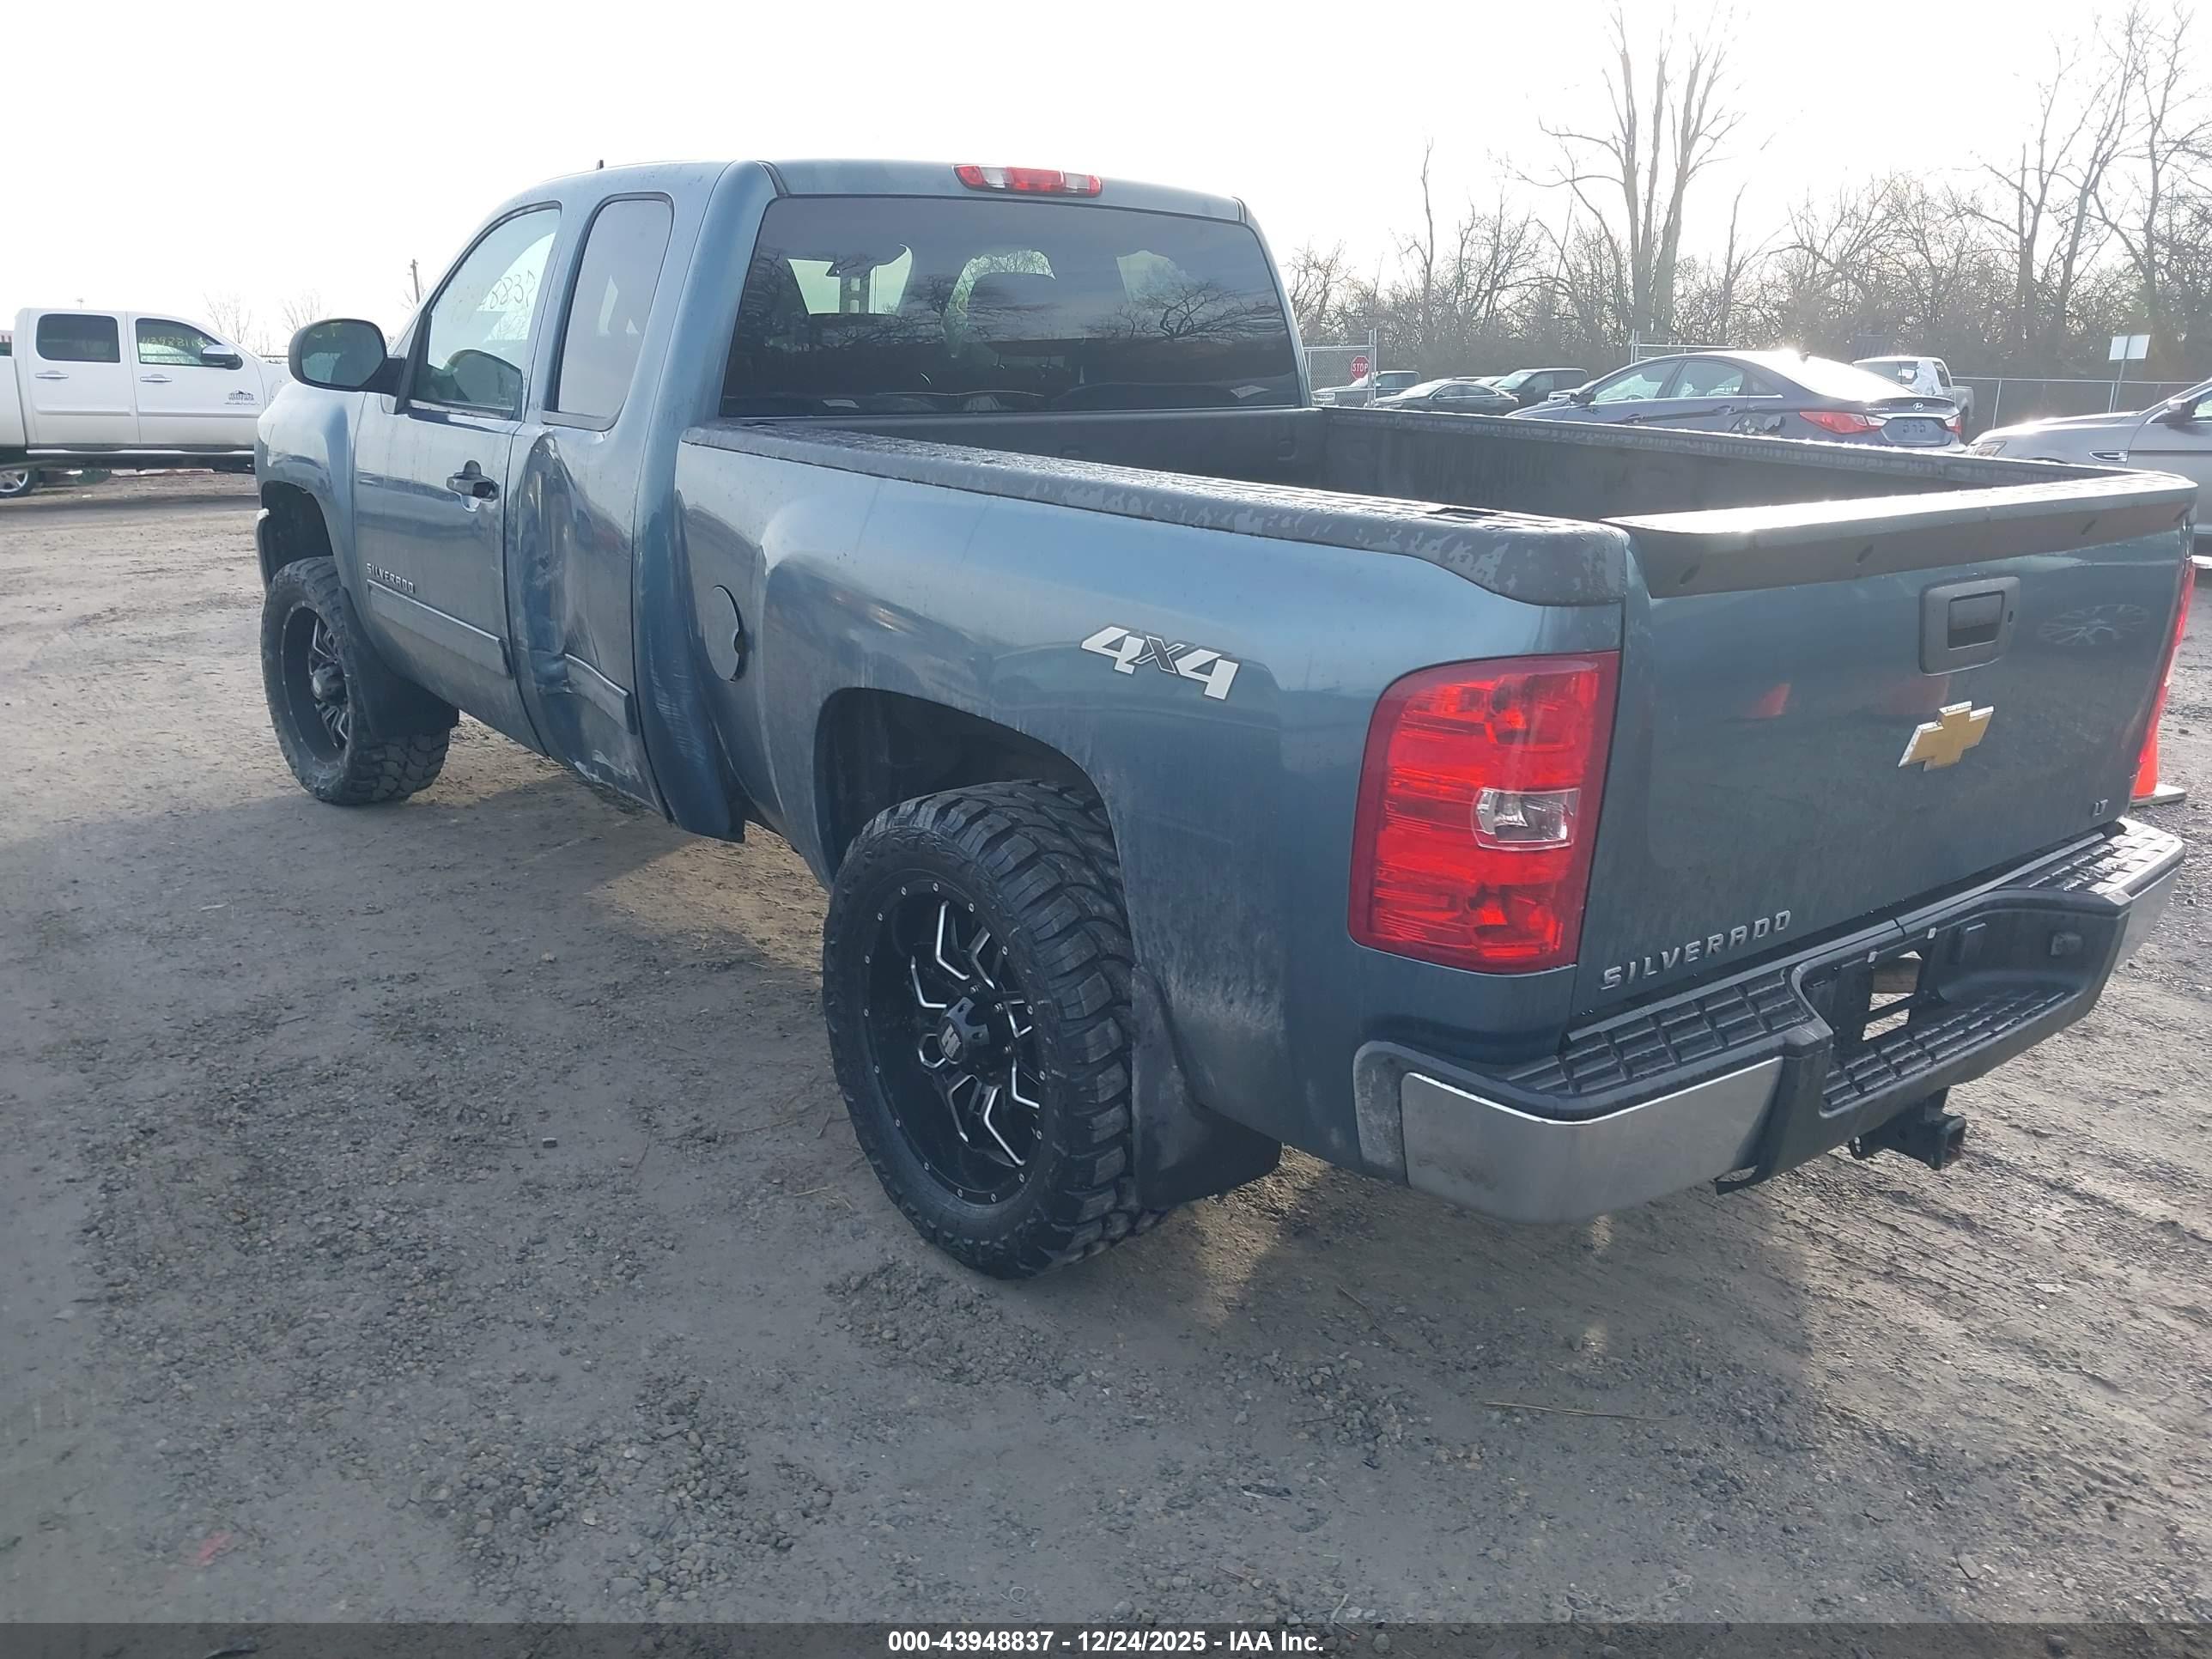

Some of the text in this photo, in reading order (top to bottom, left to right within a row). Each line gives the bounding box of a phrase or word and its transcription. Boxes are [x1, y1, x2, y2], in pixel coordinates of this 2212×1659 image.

[1352, 362, 1369, 373] STOP
[366, 562, 416, 593] SILVERADO
[2091, 799, 2109, 817] LT
[1601, 909, 1791, 990] SILVERADO
